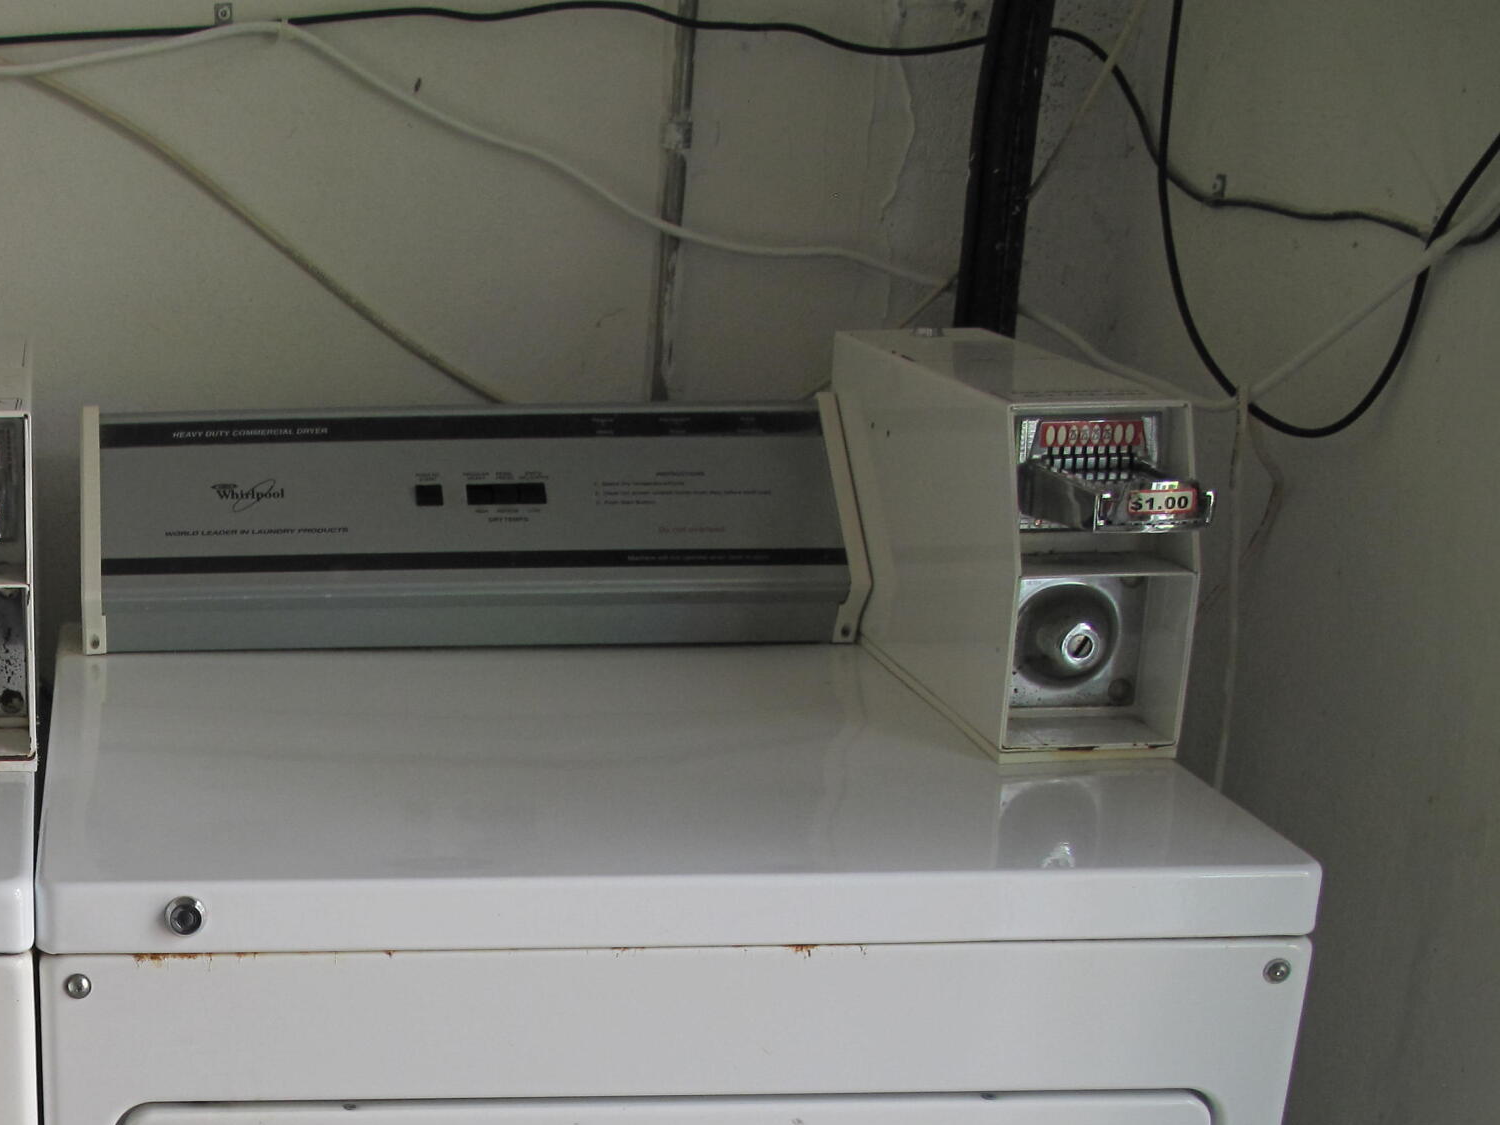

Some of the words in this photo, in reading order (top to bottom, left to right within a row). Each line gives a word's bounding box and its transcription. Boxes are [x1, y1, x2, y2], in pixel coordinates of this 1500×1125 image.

[172, 431, 204, 440] HEAVY
[205, 430, 230, 438] DUTY
[231, 428, 293, 437] COMMERCIAL
[295, 426, 329, 435] DRYER
[216, 487, 285, 503] Whirlpool
[1130, 495, 1189, 512] $1.00
